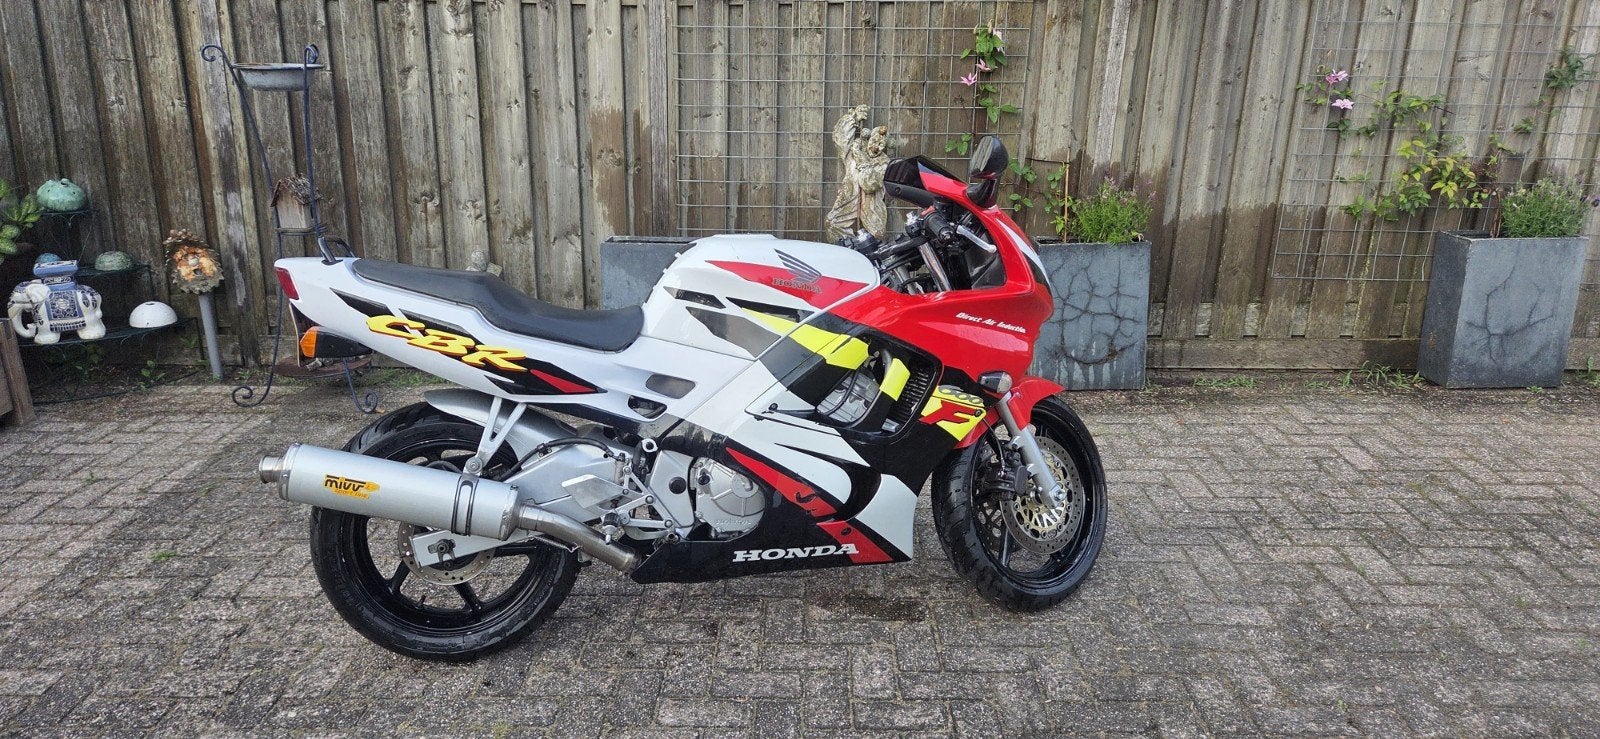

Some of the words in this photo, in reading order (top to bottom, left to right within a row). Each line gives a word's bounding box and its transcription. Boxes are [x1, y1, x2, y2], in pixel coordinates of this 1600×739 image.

[772, 277, 823, 293] HONDA
[956, 312, 983, 323] Direct
[982, 318, 997, 326] Air
[366, 315, 528, 373] CBR
[938, 384, 984, 405] 600
[918, 399, 980, 425] F
[324, 475, 366, 492] mivv
[732, 543, 859, 563] HONDA
